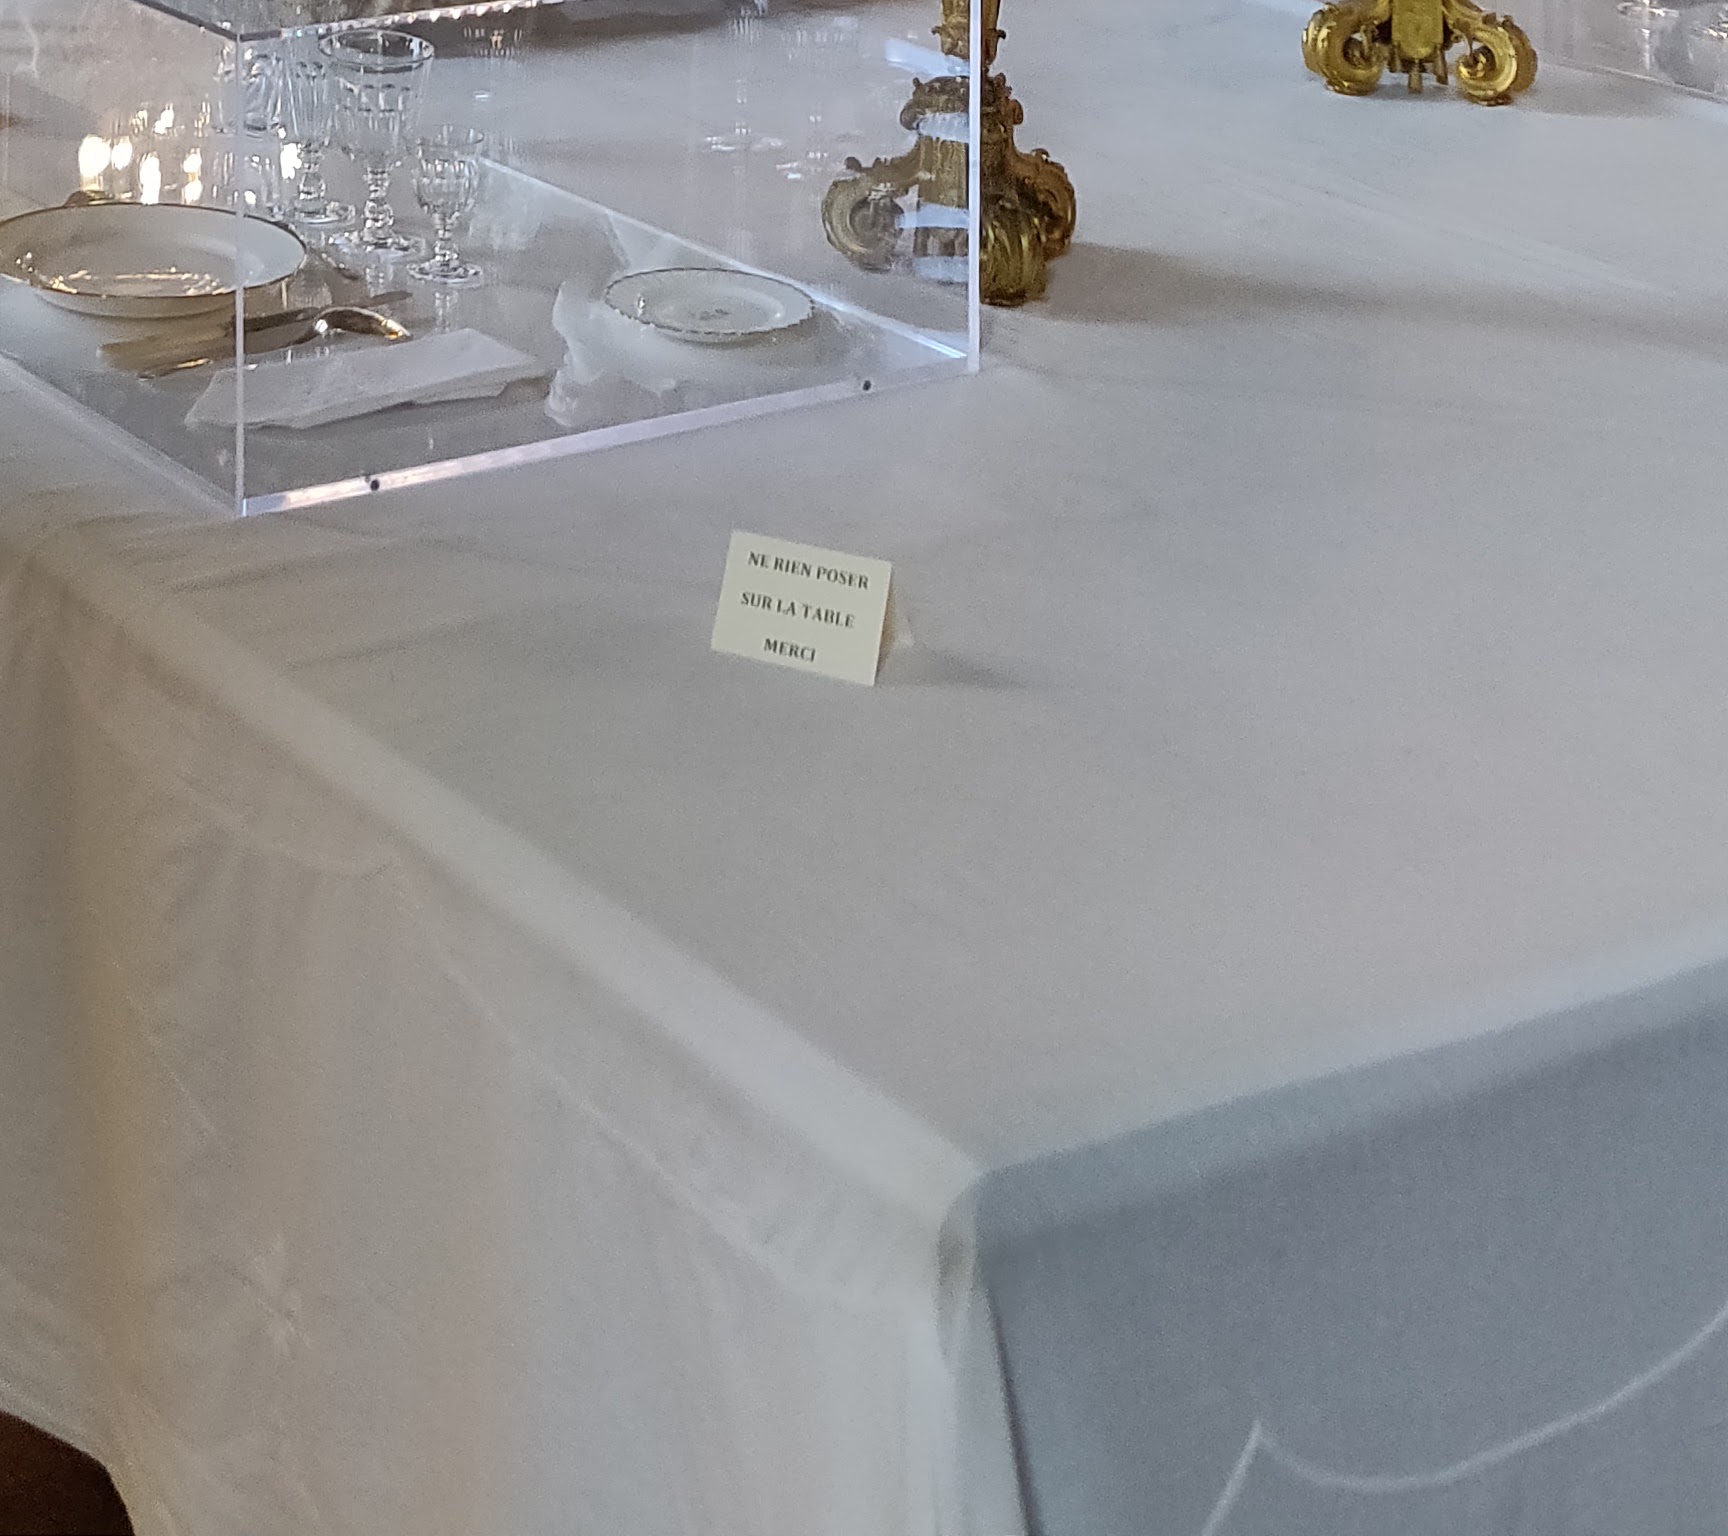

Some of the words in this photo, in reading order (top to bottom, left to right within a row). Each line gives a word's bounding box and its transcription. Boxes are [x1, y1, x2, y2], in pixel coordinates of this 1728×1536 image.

[748, 551, 769, 569] NE
[774, 556, 813, 577] RIEN
[816, 566, 870, 590] POSER
[740, 591, 773, 611] SUR
[776, 599, 797, 618] LA
[800, 603, 855, 629] TABLE
[763, 638, 816, 663] MERCI
